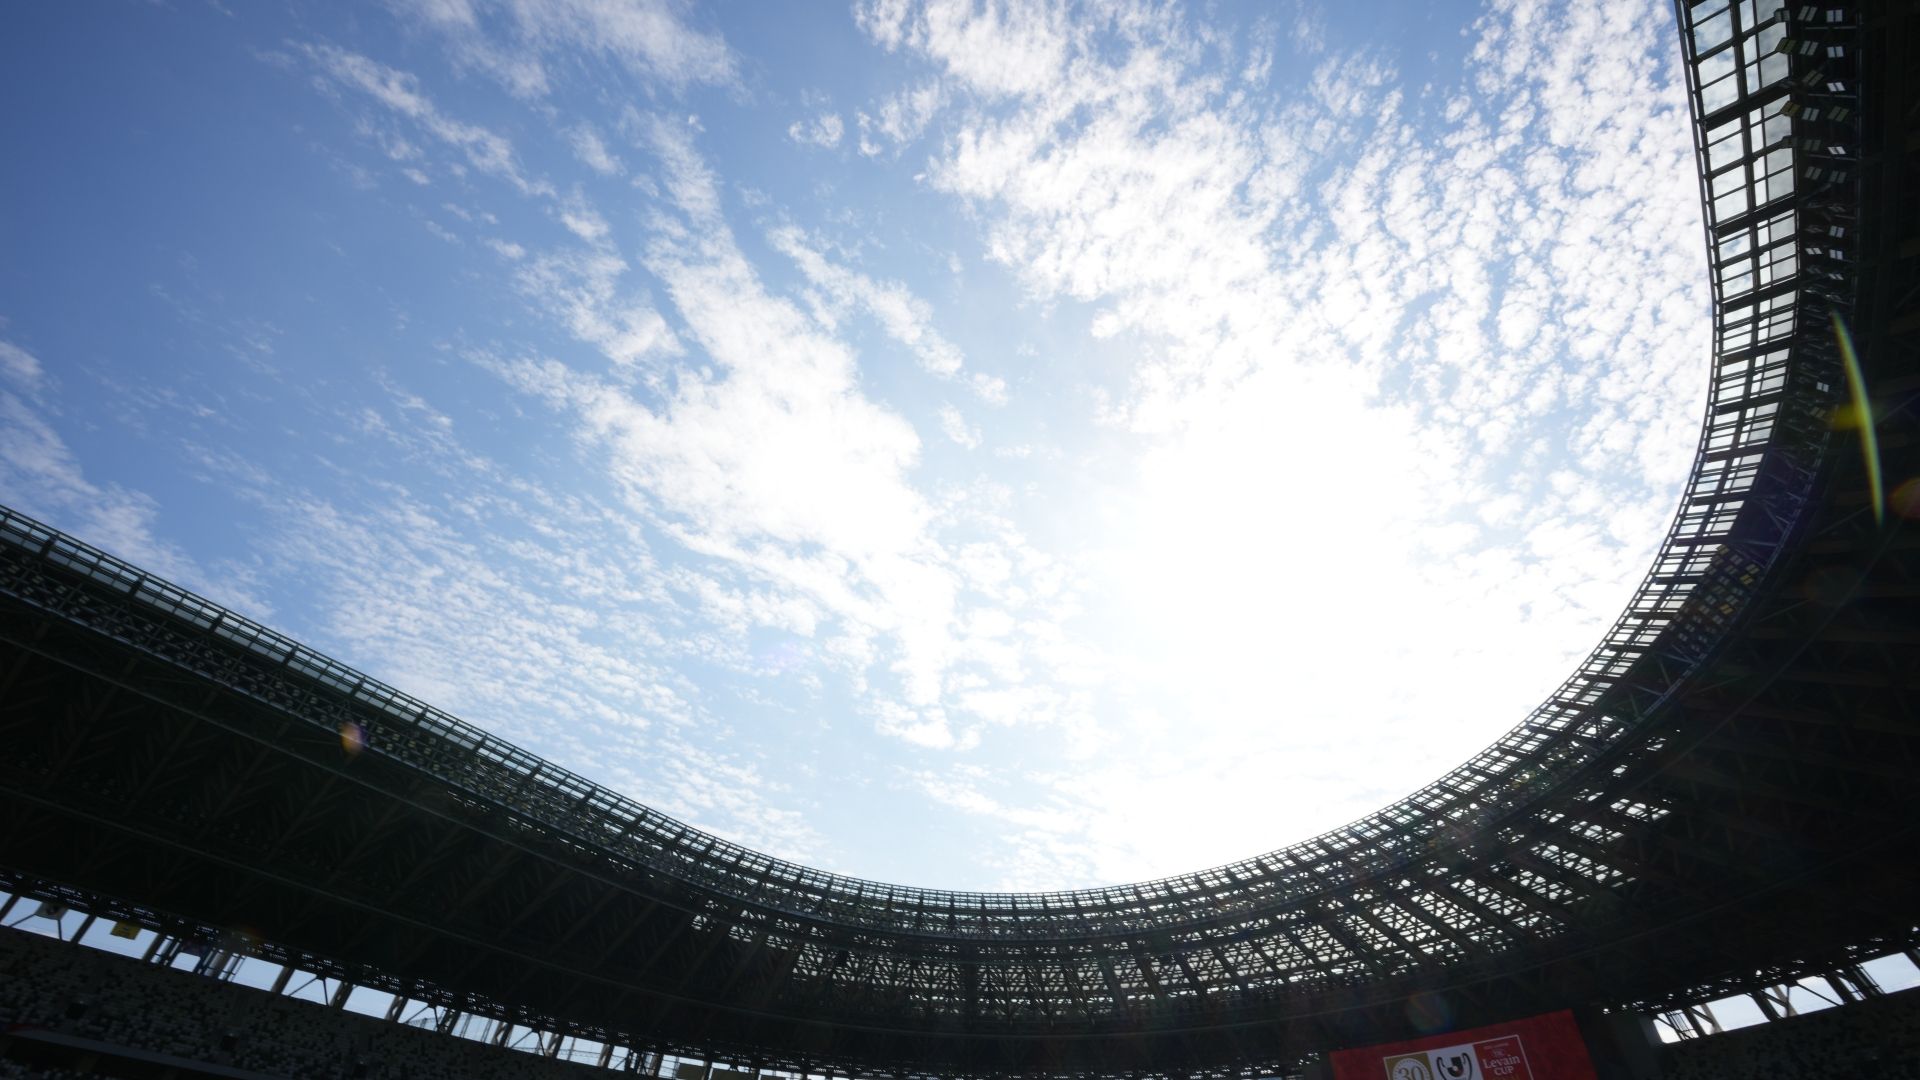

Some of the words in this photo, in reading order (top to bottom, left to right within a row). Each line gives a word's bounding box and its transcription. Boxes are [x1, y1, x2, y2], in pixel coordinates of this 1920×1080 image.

[1482, 1055, 1521, 1069] Levain
[1398, 1066, 1425, 1080] 30
[1493, 1066, 1514, 1076] CUP
